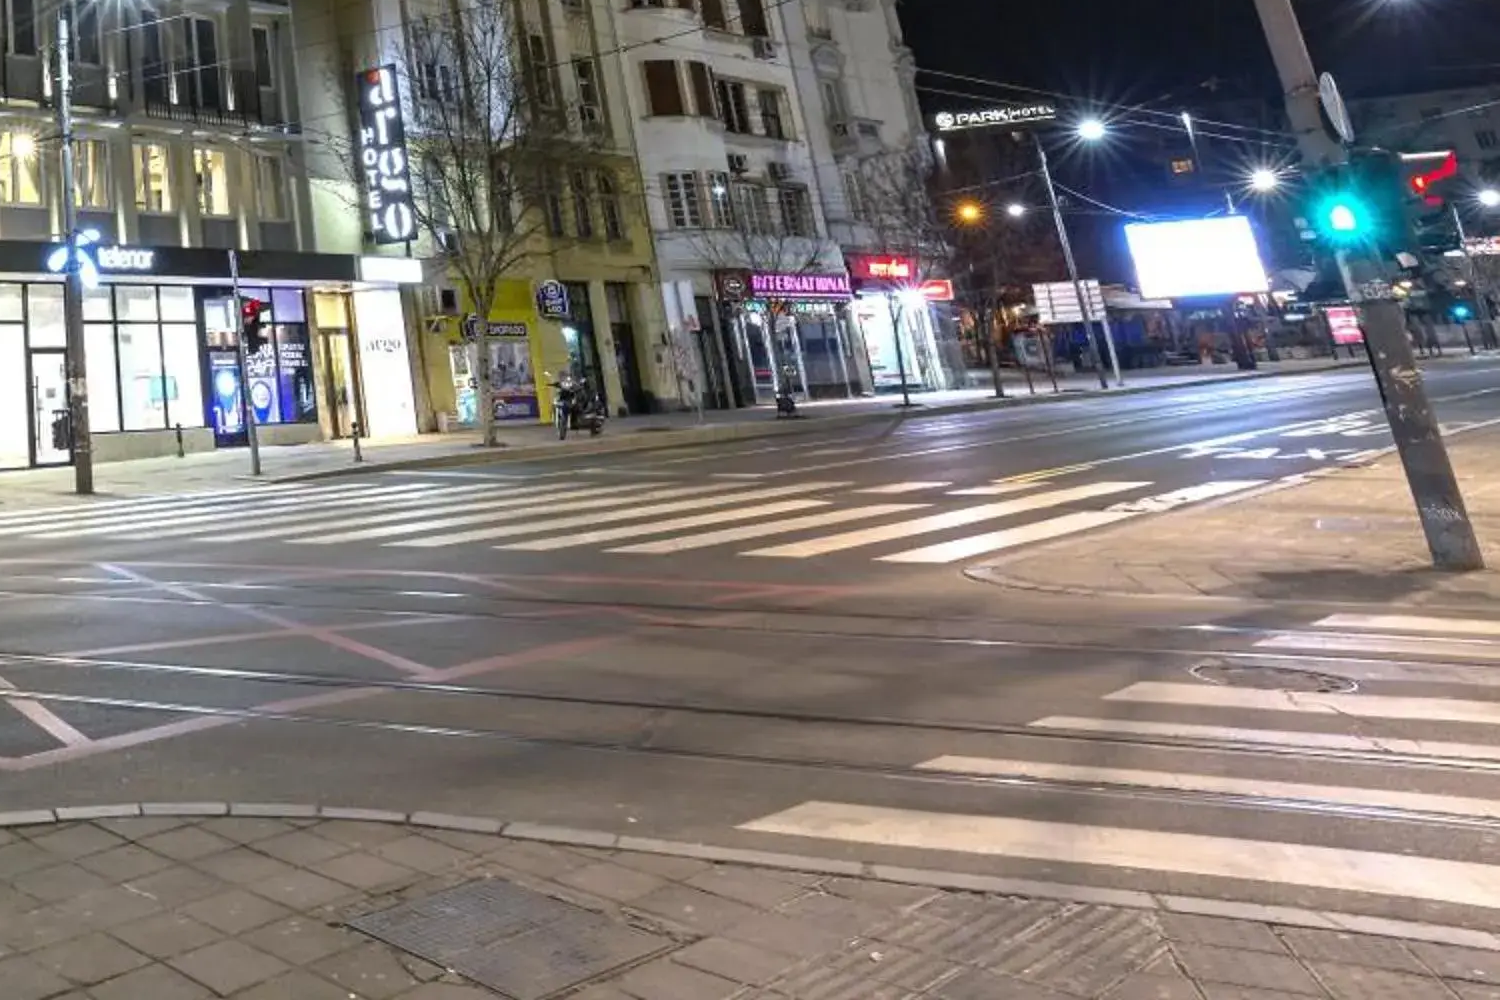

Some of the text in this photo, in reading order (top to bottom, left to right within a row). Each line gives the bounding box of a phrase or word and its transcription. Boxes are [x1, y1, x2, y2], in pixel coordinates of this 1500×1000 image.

[956, 105, 1055, 124] PARK HOTEL
[361, 127, 383, 230] HOTEL
[97, 245, 154, 270] telenor
[752, 273, 850, 291] INTERNATIONAL
